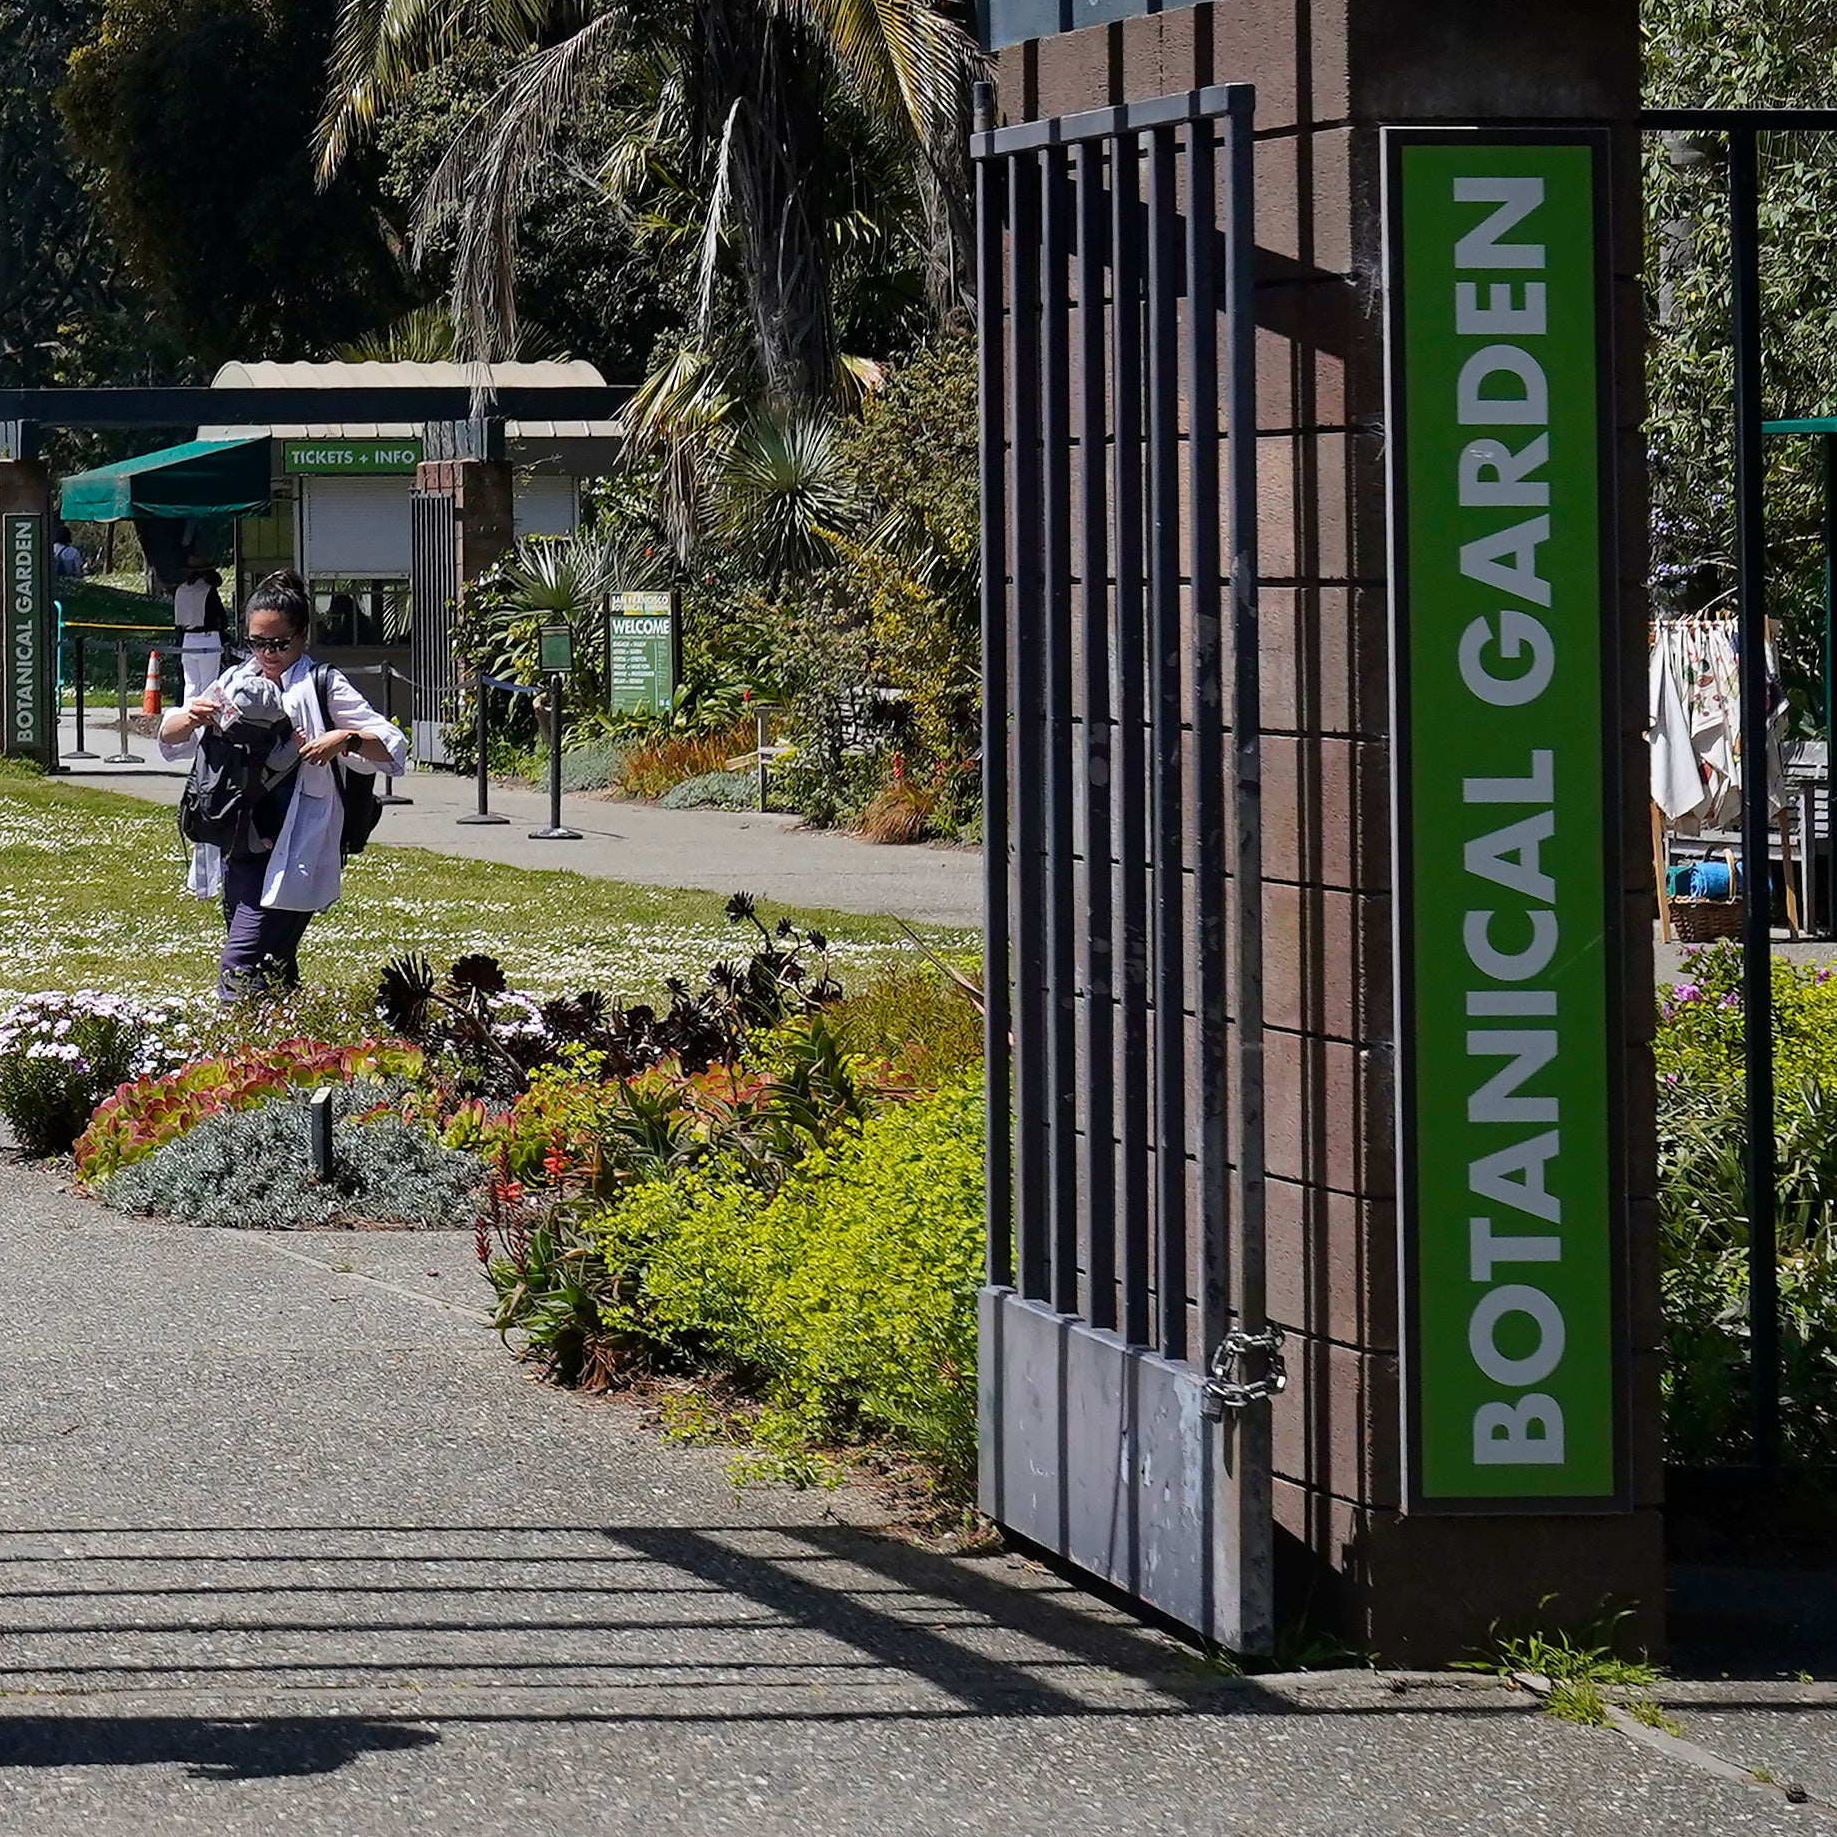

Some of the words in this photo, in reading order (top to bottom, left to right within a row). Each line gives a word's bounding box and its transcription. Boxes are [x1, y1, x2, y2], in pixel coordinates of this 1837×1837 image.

[291, 450, 354, 465] TICKETS
[374, 450, 415, 464] INFO
[1453, 176, 1554, 707] GARDEN
[14, 521, 33, 614] GARDEN
[15, 619, 35, 743] BOTANICAL
[612, 620, 670, 635] WELCOME
[1461, 749, 1566, 1465] BOTANICAL
